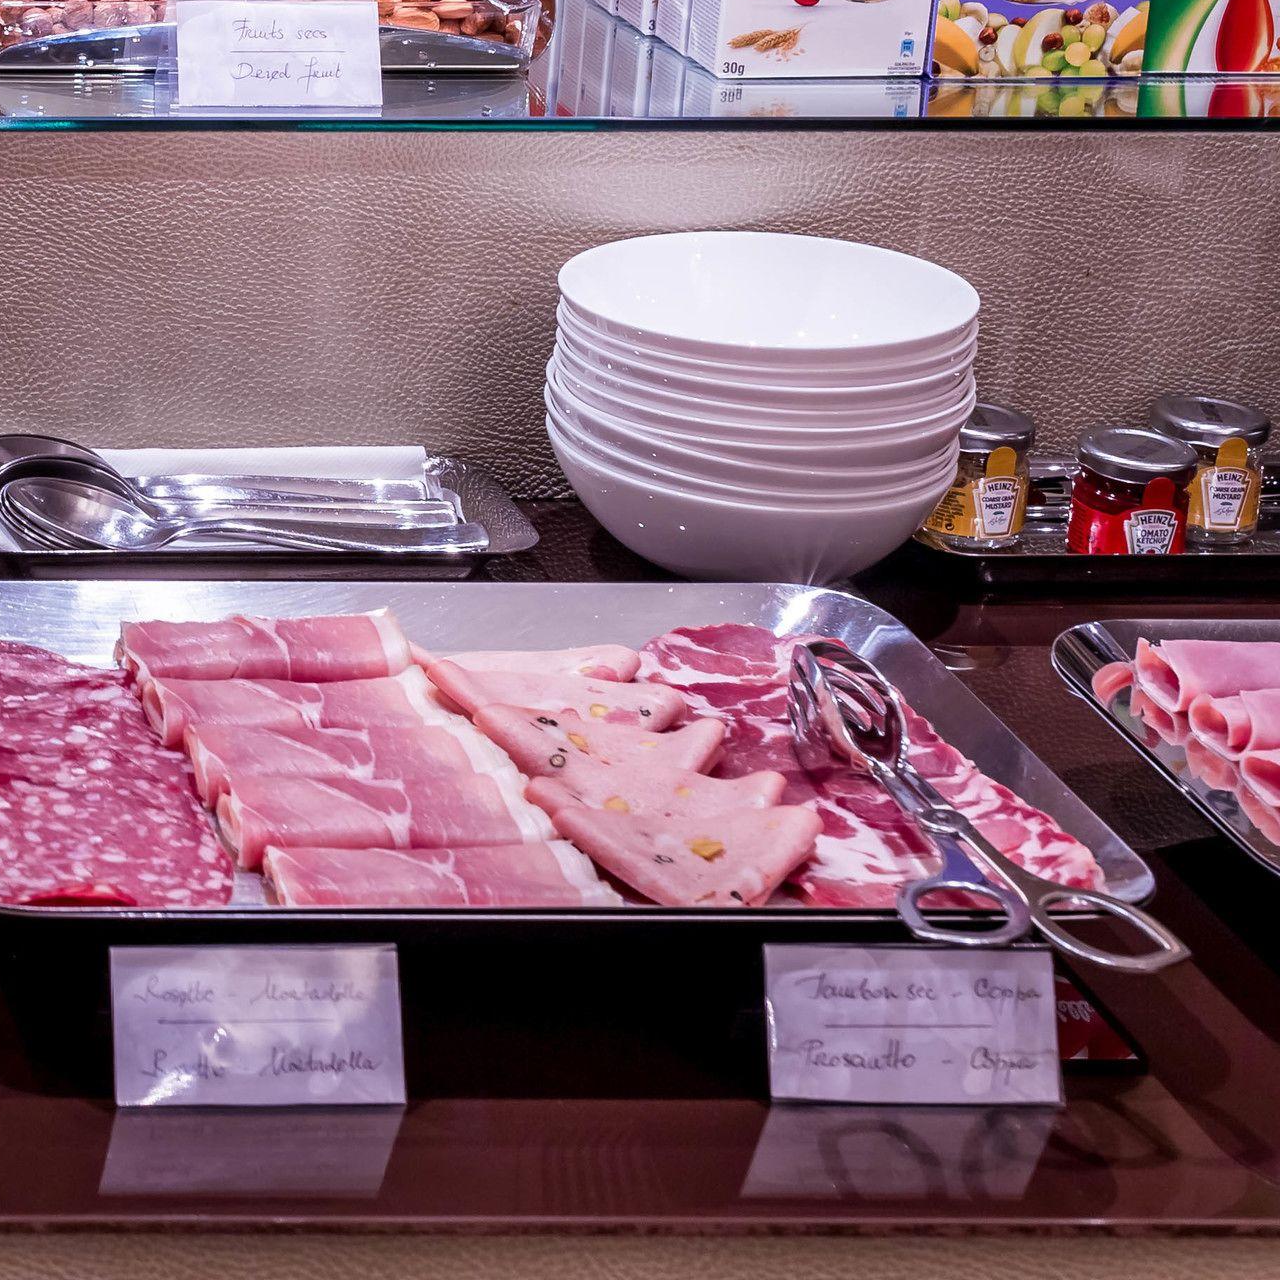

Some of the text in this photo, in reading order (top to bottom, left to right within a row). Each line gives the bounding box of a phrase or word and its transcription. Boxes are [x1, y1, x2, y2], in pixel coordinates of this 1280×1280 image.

[232, 18, 327, 41] Fruits secs
[722, 61, 745, 76] 30g
[1217, 473, 1242, 482] HEINZ
[988, 482, 1012, 492] HEINZ
[985, 502, 1011, 510] MUSTARD
[1140, 515, 1168, 525] HEINZ
[1137, 528, 1169, 538] OMATO
